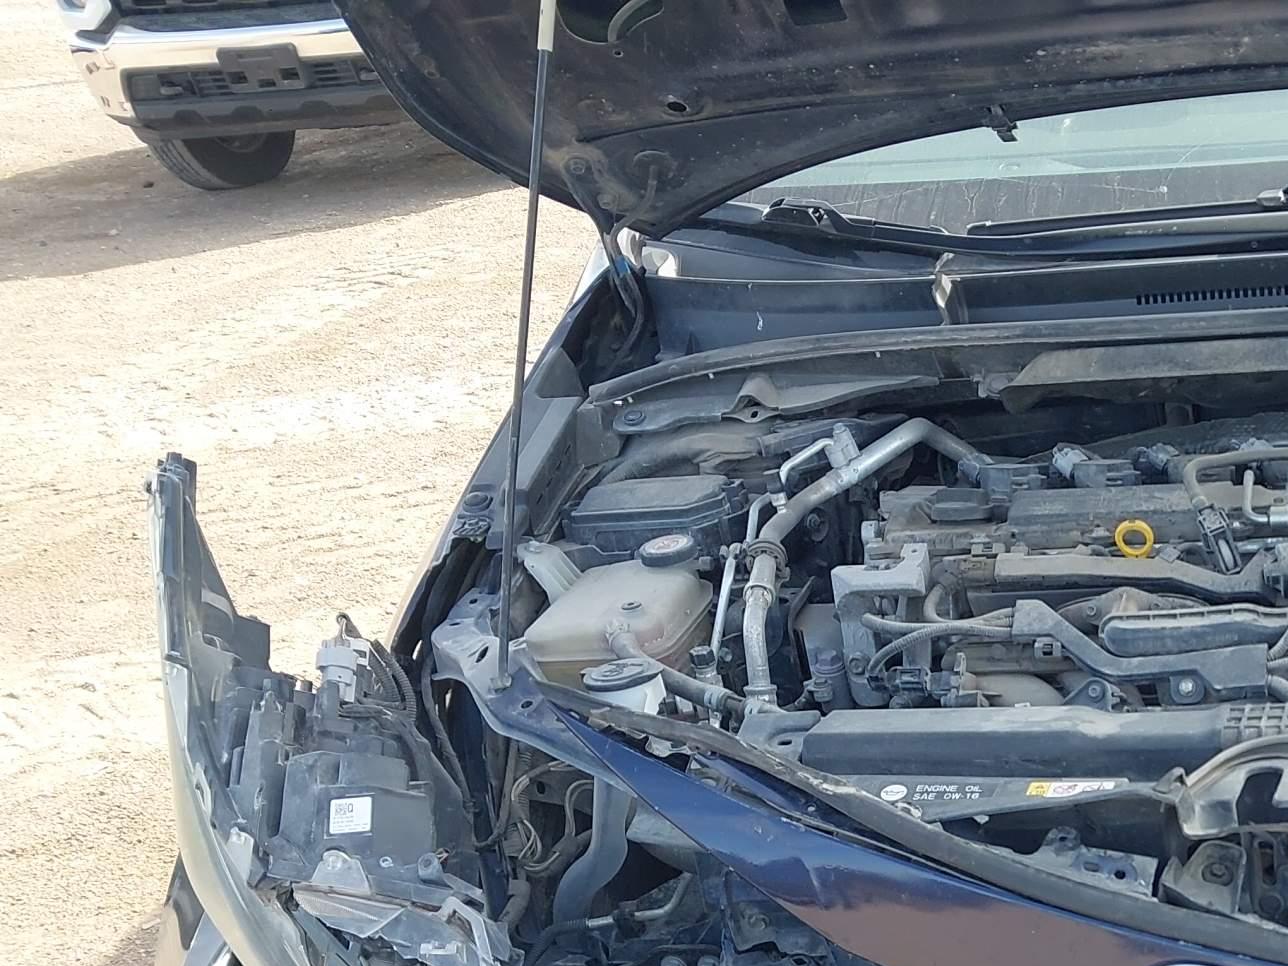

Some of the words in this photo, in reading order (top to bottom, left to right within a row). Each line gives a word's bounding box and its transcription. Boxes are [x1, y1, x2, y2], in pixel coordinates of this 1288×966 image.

[916, 784, 960, 793] ENGINE
[965, 785, 983, 793] OIL
[912, 793, 937, 801] SAE
